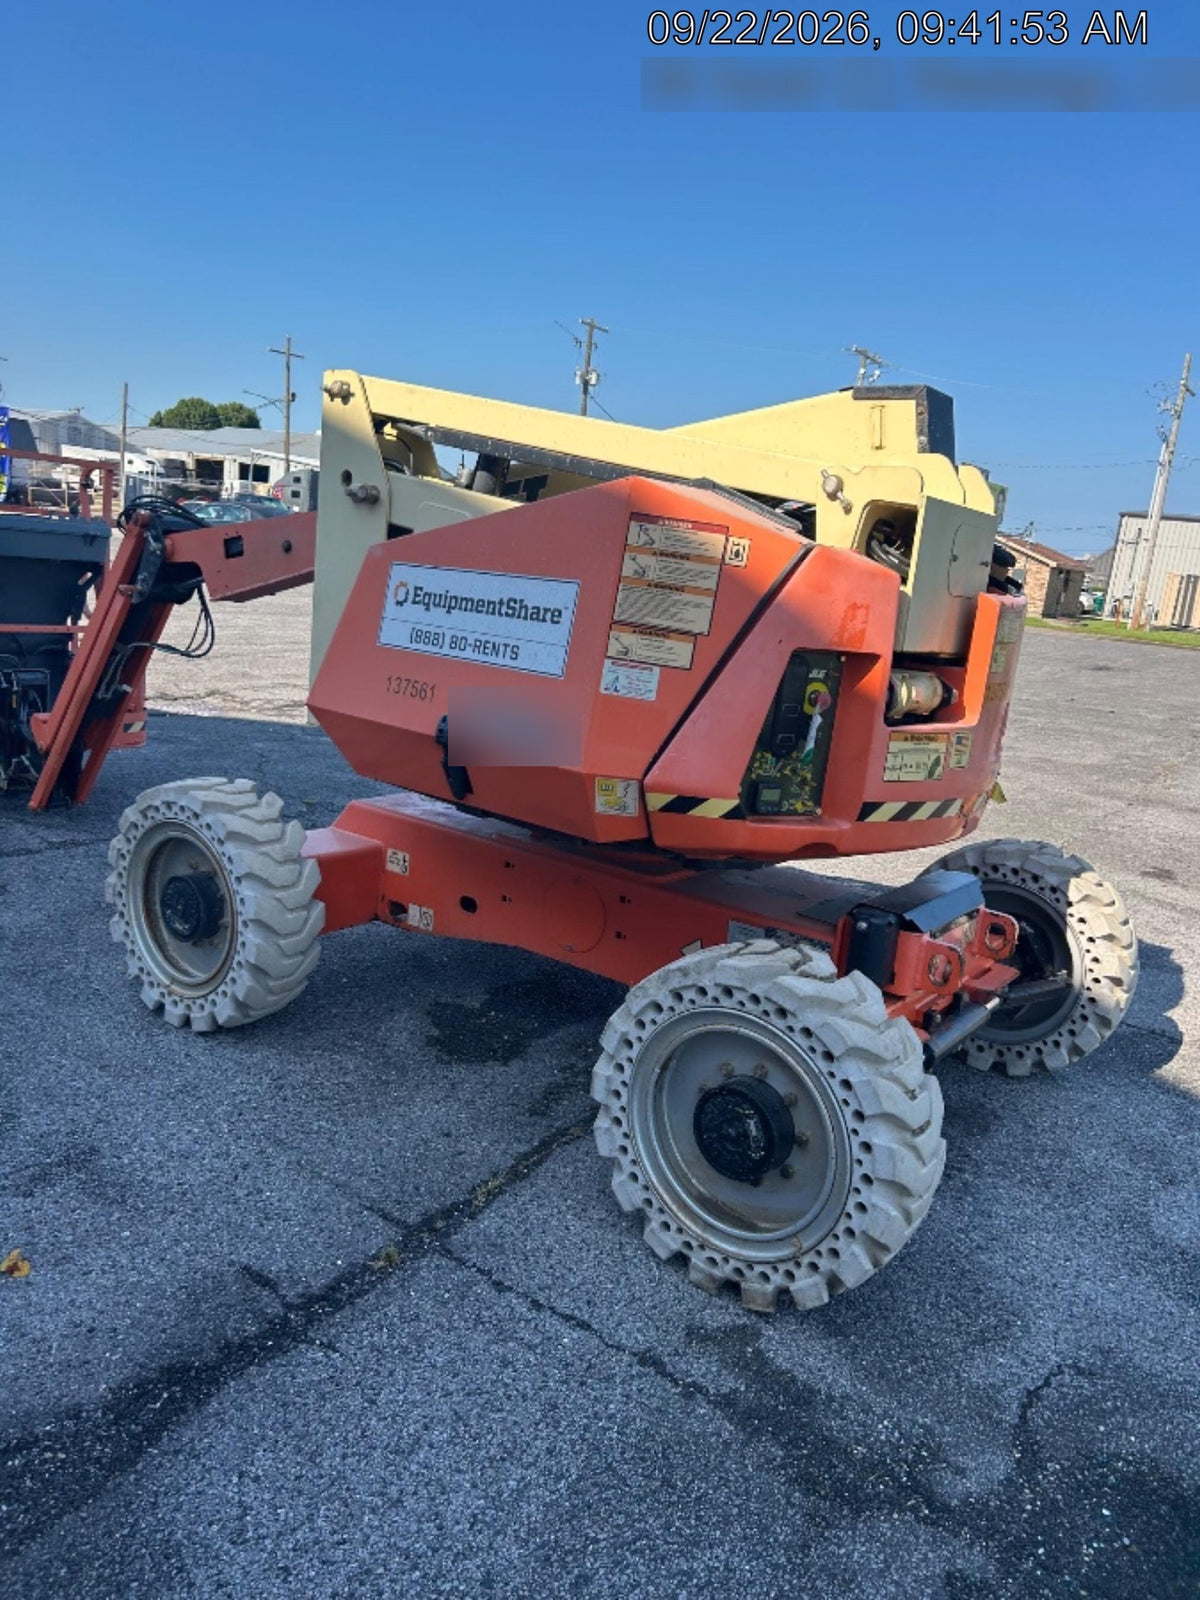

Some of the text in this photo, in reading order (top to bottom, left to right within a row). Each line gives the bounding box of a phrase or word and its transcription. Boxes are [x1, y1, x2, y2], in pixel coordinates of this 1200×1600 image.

[411, 586, 563, 624] EquipmentShare
[409, 627, 520, 660] (888) 80-RENTS
[387, 676, 437, 702] 137561
